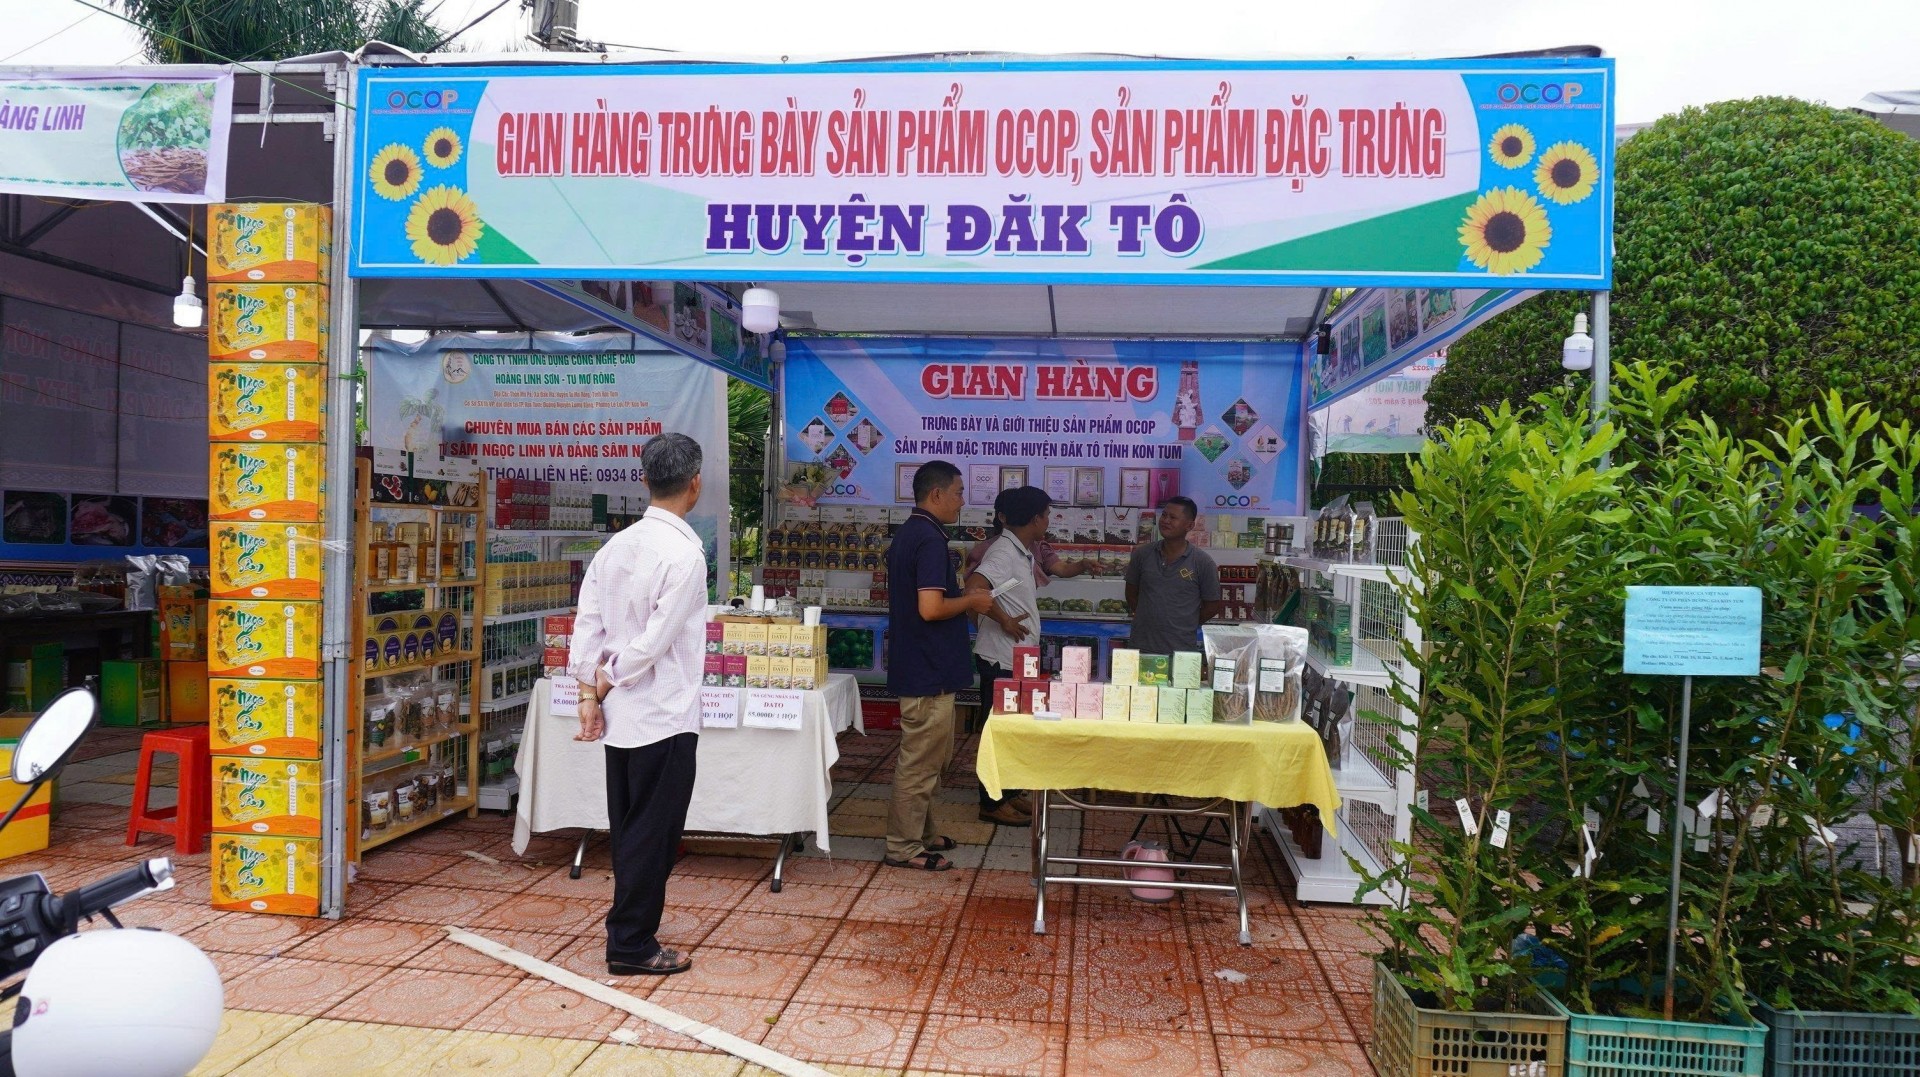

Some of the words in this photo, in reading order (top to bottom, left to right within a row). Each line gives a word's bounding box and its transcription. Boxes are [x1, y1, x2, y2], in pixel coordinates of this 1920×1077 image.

[387, 89, 459, 110] OCOP
[1498, 82, 1583, 104] OCOP
[42, 104, 86, 131] LINH
[497, 111, 565, 176] GIAN
[571, 98, 651, 176] HÀNG
[658, 103, 752, 176] TRƯNG
[760, 97, 820, 176] BÀY
[826, 88, 889, 176] SẢN
[896, 83, 985, 177] PHẨM
[995, 109, 1080, 185] OCOP,
[1090, 82, 1155, 177] SẢN
[1164, 82, 1256, 177] PHẨM
[1265, 94, 1329, 190] ĐẶC
[1340, 102, 1444, 178] TRƯNG
[707, 193, 925, 263] HUYỆN
[947, 195, 1085, 254] ĐĂK
[1110, 194, 1202, 254] TÔ
[473, 353, 494, 365] CÔNG
[496, 353, 506, 365] TY
[508, 353, 528, 365] TNHH
[530, 352, 547, 366] ỨNG
[548, 353, 569, 368] DỤNG
[571, 352, 594, 366] CÔNG
[596, 352, 617, 367] NGHỆ
[620, 353, 636, 365] CAO
[496, 372, 521, 385] HOÀNG
[524, 374, 541, 385] LINH
[544, 373, 560, 385] SƠN
[567, 374, 577, 385] TU
[579, 373, 592, 385] MƠ
[594, 373, 615, 385] RÔNG
[921, 364, 1026, 399] GIAN
[1036, 359, 1156, 400] HÀNG
[465, 420, 512, 435] CHUYÊN
[517, 422, 541, 435] MUA
[546, 420, 569, 436] BÁN
[573, 420, 595, 435] CÁC
[599, 419, 623, 435] SẢN
[627, 417, 662, 435] PHẨM
[921, 415, 958, 431] TRƯNG
[960, 414, 982, 431] BÀY
[985, 415, 1000, 431] VÀ
[1002, 415, 1025, 432] GIỚI
[1028, 416, 1060, 436] THIỆU
[1063, 414, 1086, 434] SẢN
[1089, 414, 1121, 435] PHẨM
[1126, 420, 1156, 435] OCOP
[450, 441, 478, 456] SÂM
[483, 443, 516, 460] NGỌC
[520, 444, 545, 457] LINH
[549, 443, 565, 457] VÀ
[567, 441, 598, 458] ĐẢNG
[602, 442, 628, 458] SÂM
[895, 435, 918, 455] SẢN
[921, 434, 953, 456] PHẨM
[956, 440, 978, 458] ĐẶC
[981, 440, 1018, 457] TRƯNG
[1021, 440, 1057, 460] HUYỆN
[1060, 441, 1083, 458] ĐĂK
[1086, 441, 1100, 458] TÔ
[1103, 439, 1129, 459] TỈNH
[1132, 445, 1155, 459] KON
[1158, 446, 1182, 460] TUM
[534, 464, 565, 481] LIÊN
[570, 465, 592, 485] HỆ:
[597, 469, 626, 482] 0934
[1215, 495, 1260, 507] OCOP
[718, 712, 734, 721] HỘP
[782, 713, 798, 721] HỘP
